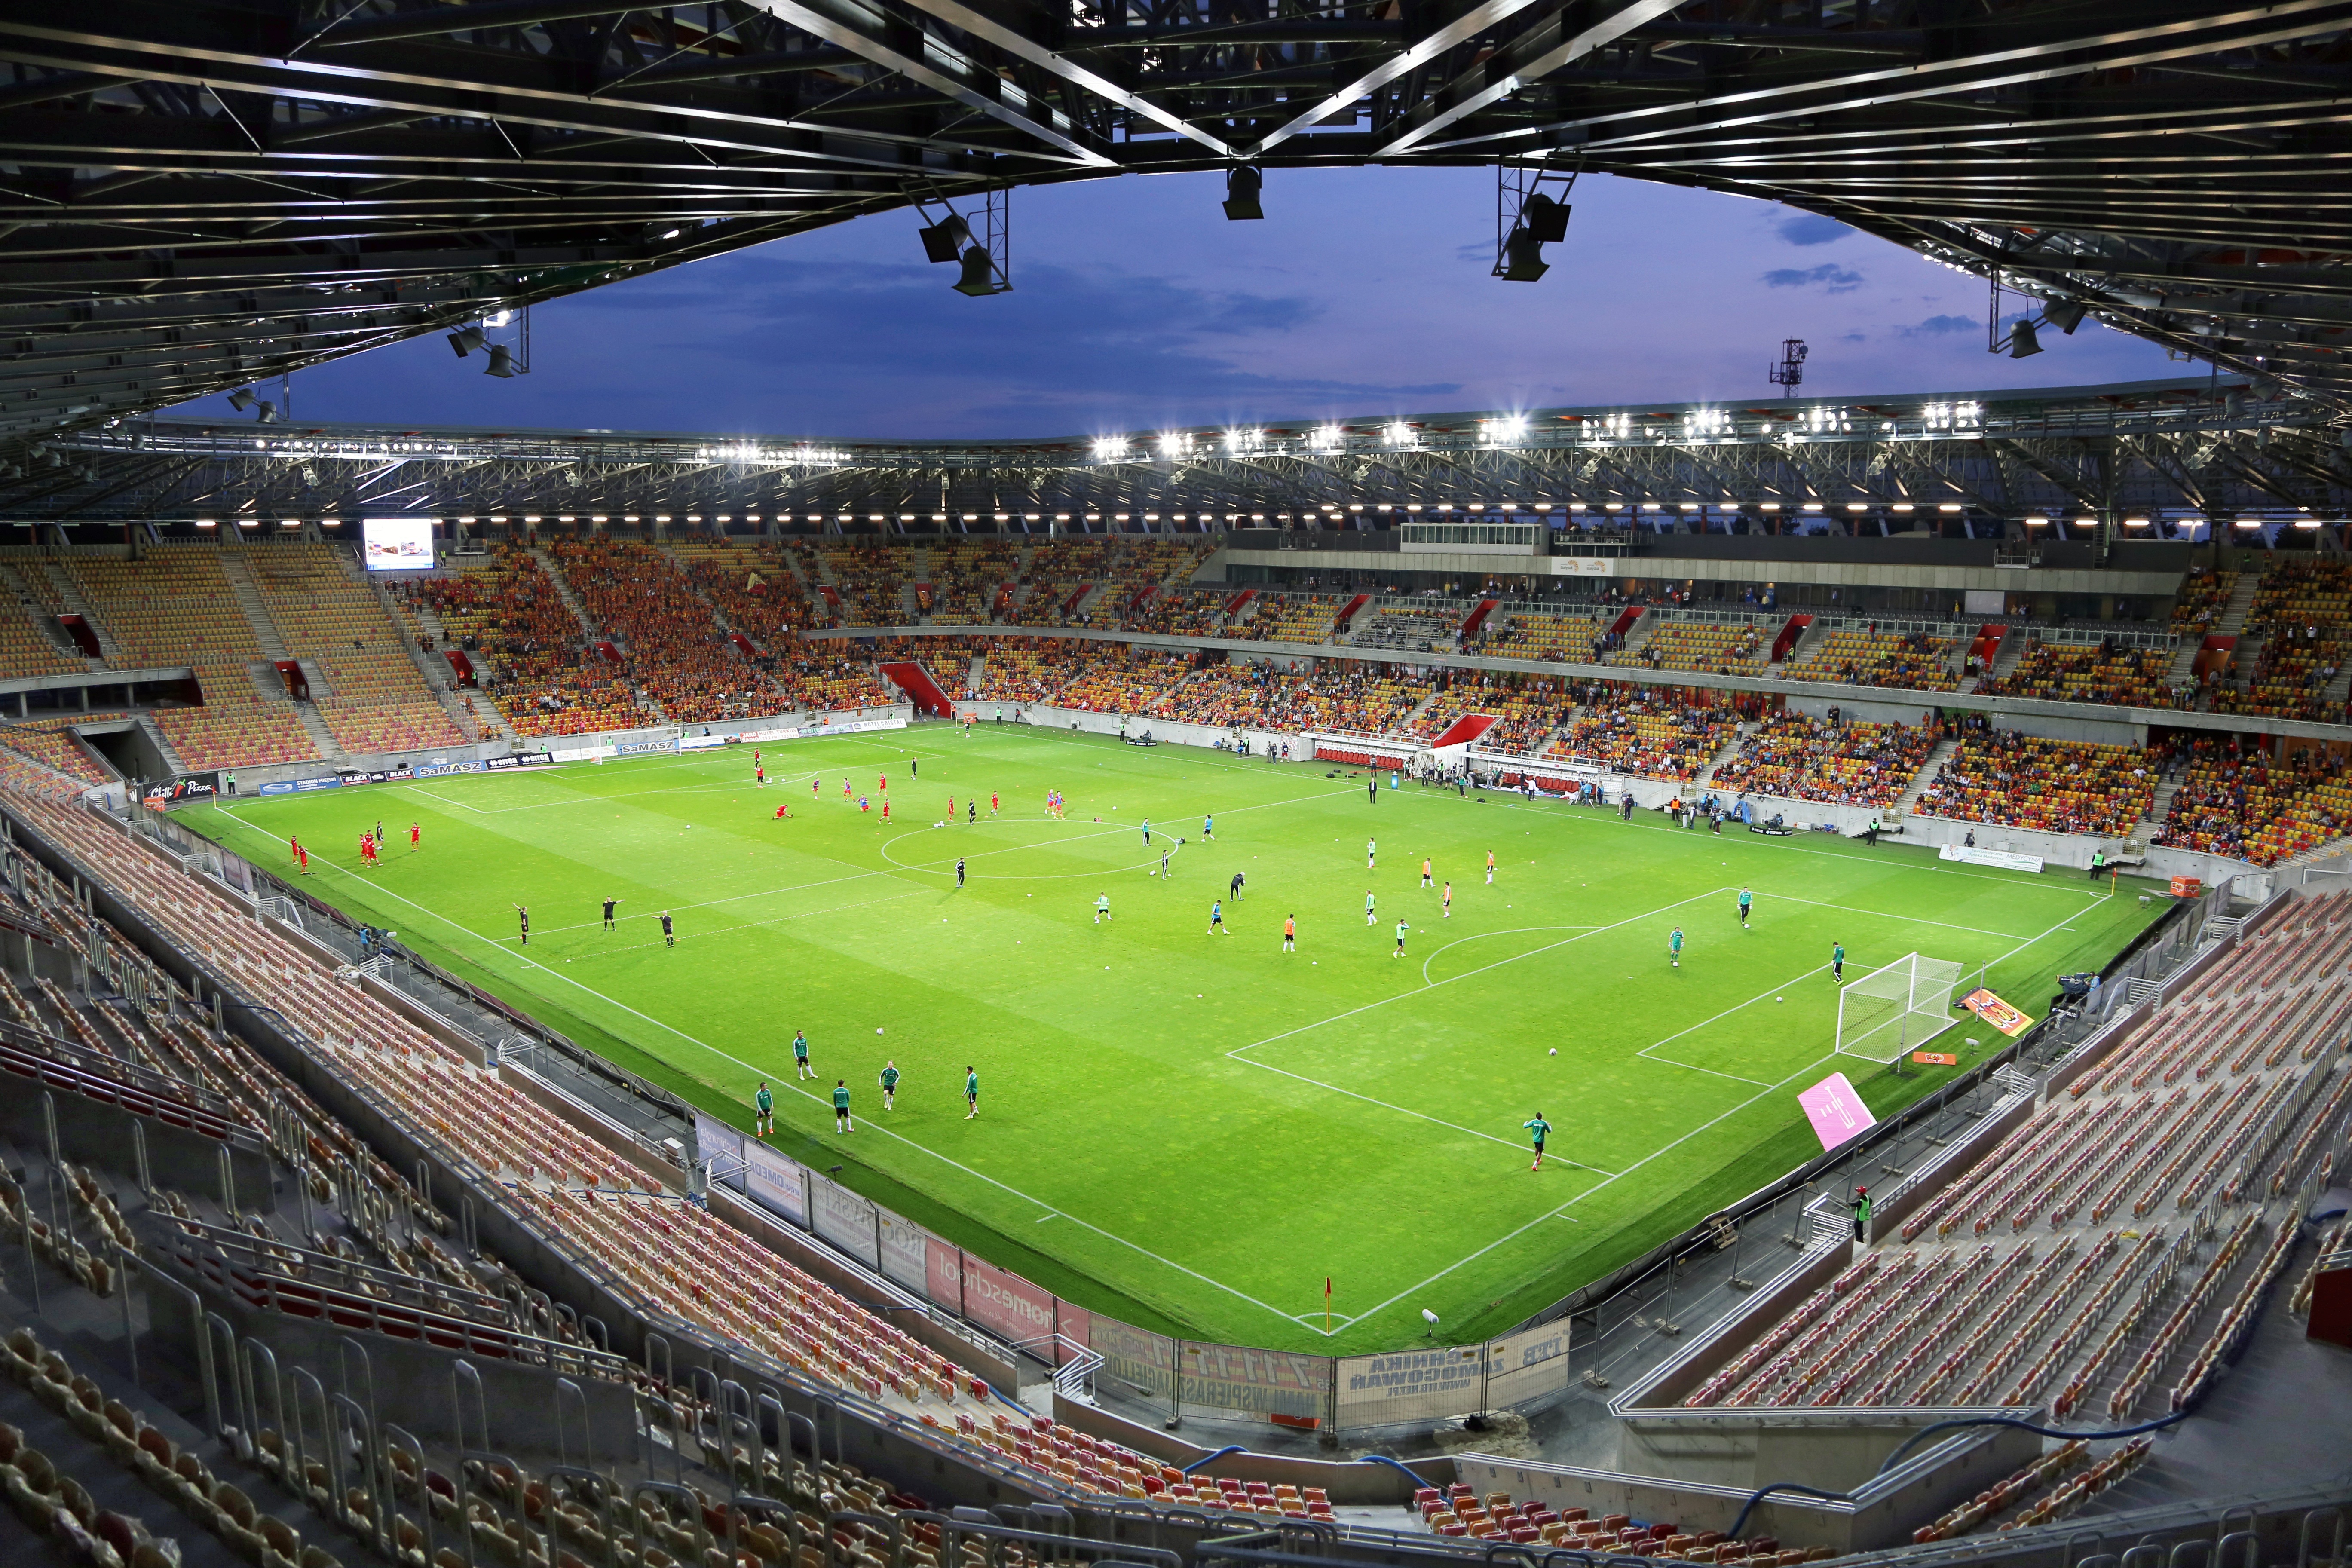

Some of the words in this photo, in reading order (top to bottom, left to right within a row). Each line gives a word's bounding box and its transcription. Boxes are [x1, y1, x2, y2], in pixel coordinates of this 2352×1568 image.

[622, 742, 674, 753] SaMASZ
[497, 757, 518, 766] errea
[530, 753, 550, 762] errea
[420, 762, 482, 776] SaMASZ
[345, 774, 368, 782] BLACK
[150, 786, 174, 799] Chilli
[187, 781, 214, 795] Pizza
[2006, 854, 2041, 863] MEDYCYNA
